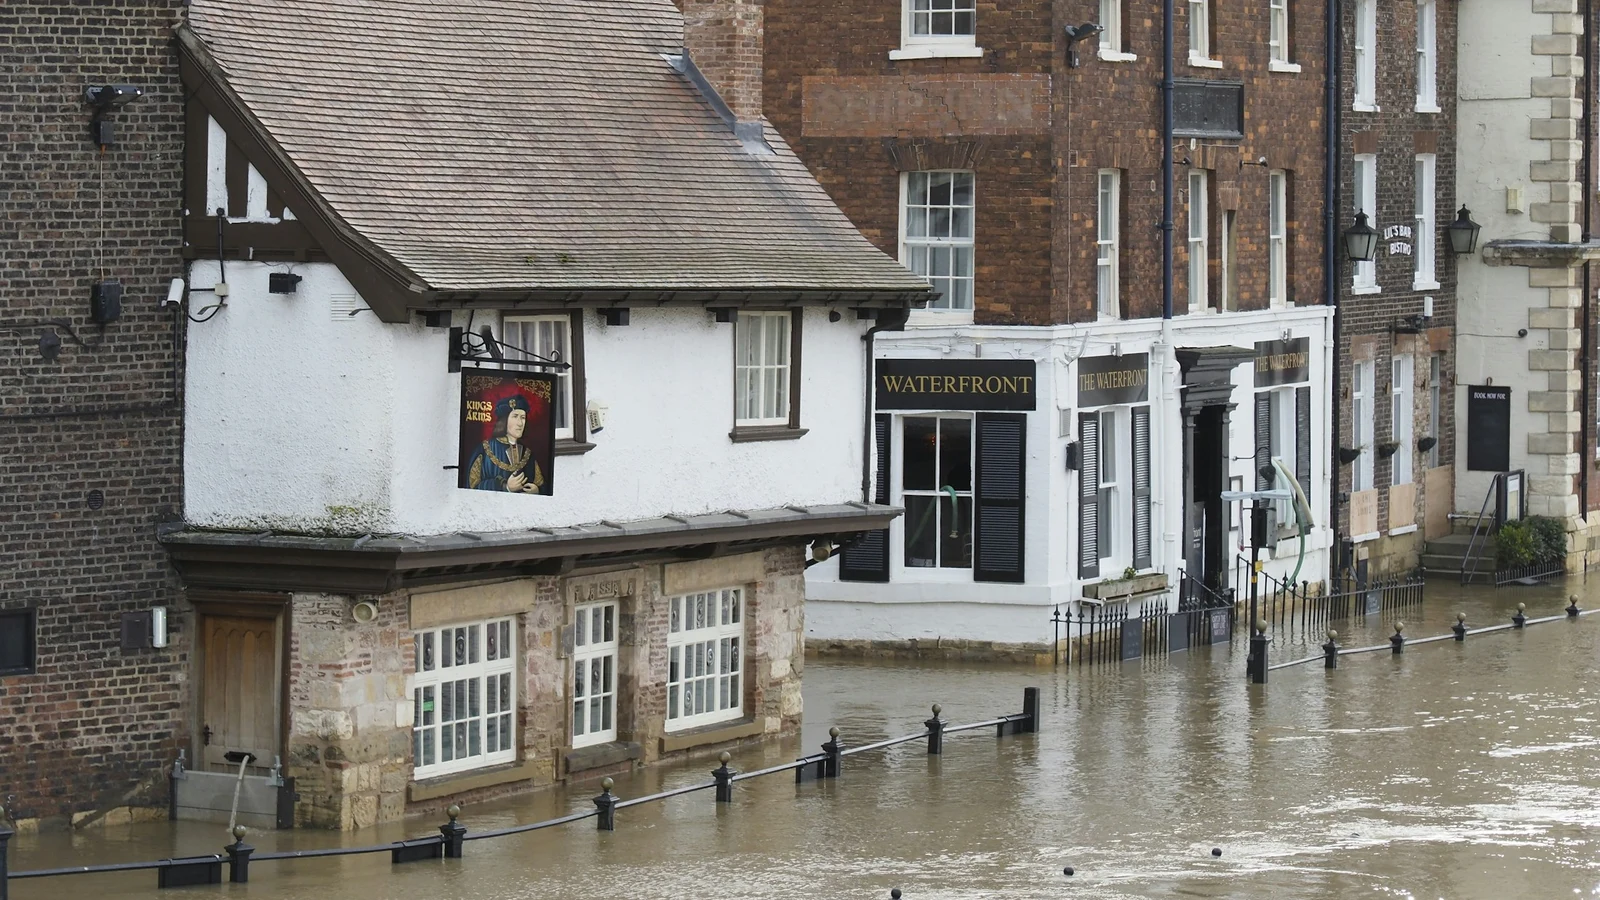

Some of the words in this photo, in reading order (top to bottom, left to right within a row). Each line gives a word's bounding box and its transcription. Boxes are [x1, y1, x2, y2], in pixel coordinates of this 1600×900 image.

[1399, 225, 1411, 238] BAR
[1390, 242, 1411, 255] BISTRO
[1255, 356, 1268, 372] THE
[1269, 352, 1309, 370] WATERFRONT
[883, 375, 1033, 394] WATERFRONT
[1080, 374, 1095, 391] THE
[1096, 369, 1147, 389] WATERFRONT
[466, 401, 493, 411] KINGS
[466, 410, 492, 422] ARMS
